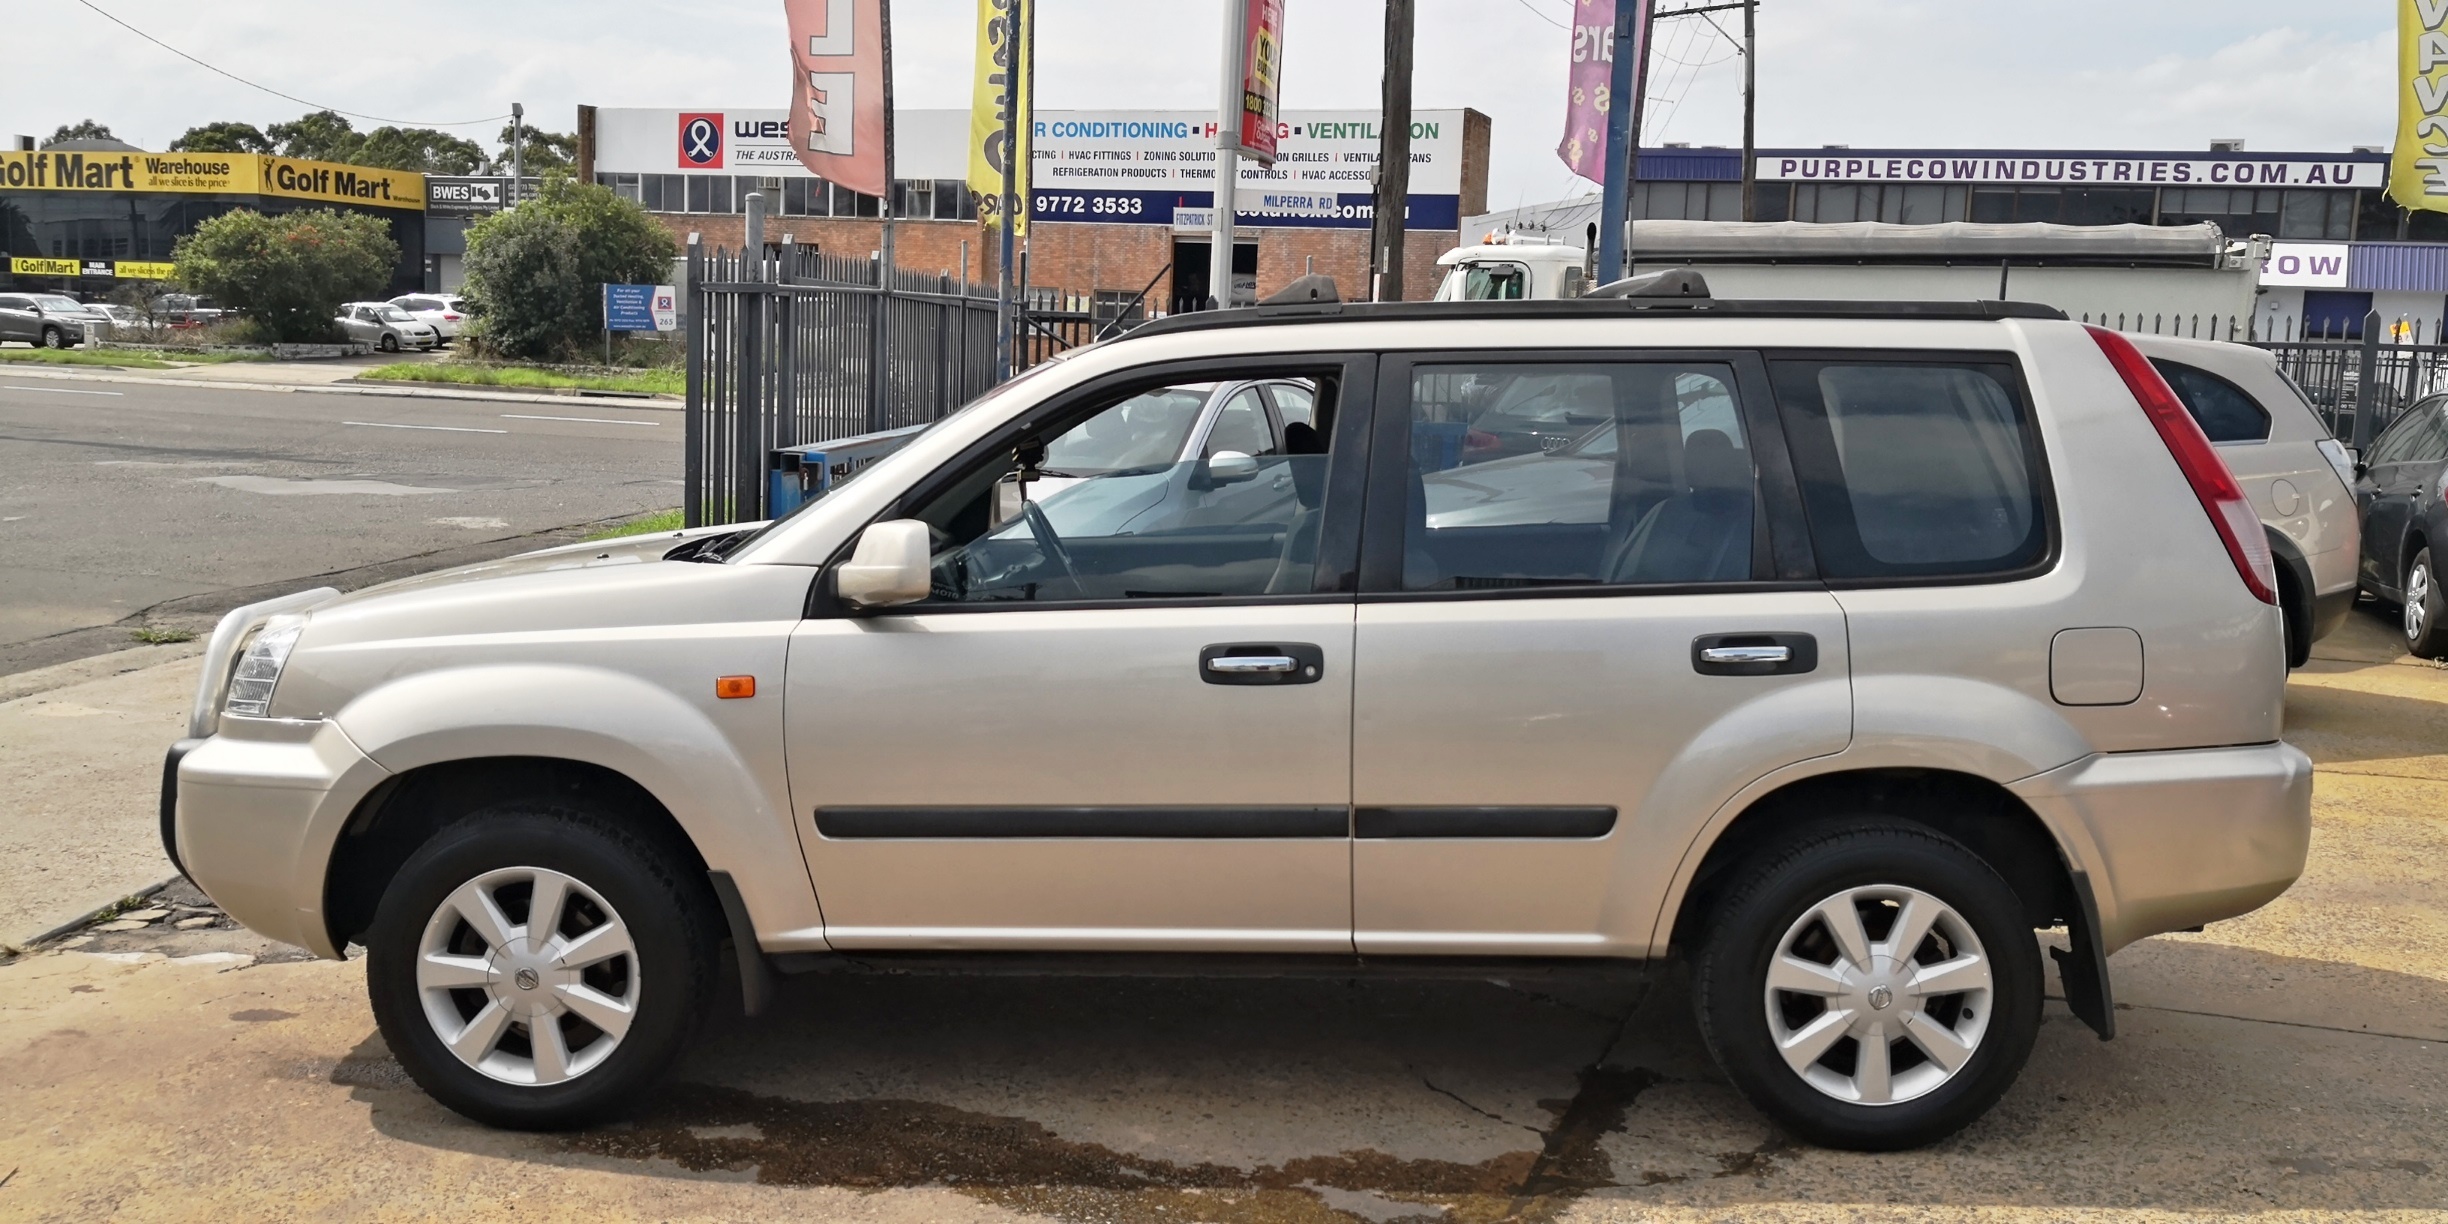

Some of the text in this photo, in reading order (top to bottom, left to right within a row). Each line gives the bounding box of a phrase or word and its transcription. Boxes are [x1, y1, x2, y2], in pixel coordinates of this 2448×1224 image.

[1245, 94, 1262, 113] 1800
[1052, 122, 1188, 139] CONDITIONING
[1307, 122, 1439, 139] VENTILON
[736, 150, 756, 160] THE
[1032, 150, 1057, 160] CTING
[1068, 151, 1091, 161] HVAC
[1093, 151, 1132, 161] FITTINGS
[1143, 151, 1177, 161] ZONING
[1179, 151, 1216, 162] SOLUTIO
[1292, 152, 1330, 163] GRILLES
[1343, 152, 1381, 163] VENTILA
[55, 154, 134, 189] Mart
[145, 157, 230, 175] Warehouse
[1781, 159, 2354, 185] PURPLECOWINDUSTRIES.COM.AU
[1052, 167, 1371, 181] REFRIGERATION PRODUCTS THERMO CONTROLS HVAC ACCESSO
[148, 176, 228, 190] all we slice is the price
[277, 164, 391, 201] Golf Mart
[432, 186, 469, 200] BWES
[1036, 196, 1143, 215] 9772 3533
[1263, 194, 1333, 210] MILPERRA RD
[1176, 213, 1213, 226] FITZPATRICK ST
[21, 260, 75, 274] Golf Mart
[82, 268, 114, 276] ENTRANCE
[659, 318, 674, 326] 265
